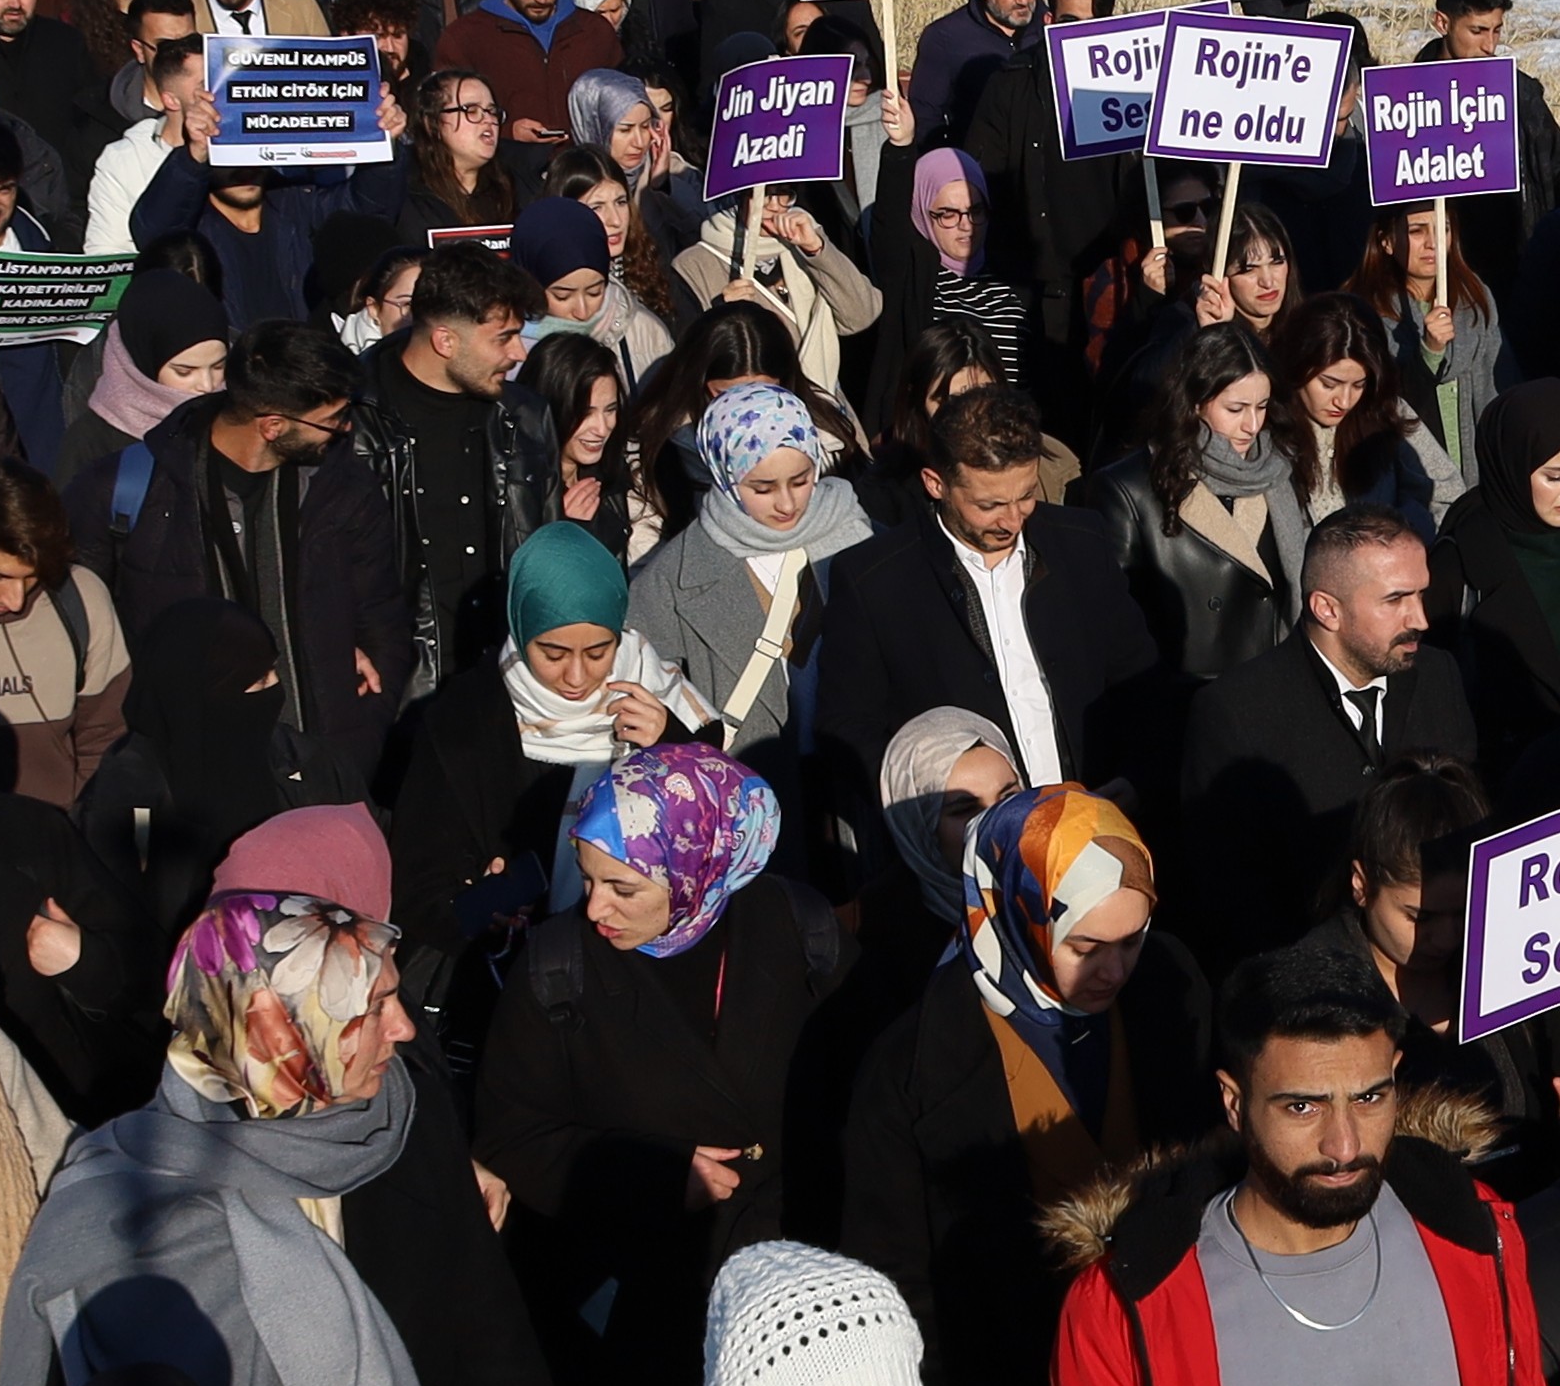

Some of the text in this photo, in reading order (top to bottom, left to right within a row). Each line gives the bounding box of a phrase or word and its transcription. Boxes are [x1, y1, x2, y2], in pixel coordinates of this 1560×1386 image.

[302, 51, 367, 66] KAMPÜS
[1194, 37, 1312, 89] Rojin'e
[232, 82, 364, 99] ETKİN CİTÖK İÇİN
[722, 76, 835, 121] Jin Jiyan
[1373, 79, 1506, 139] Rojin İçin
[246, 115, 350, 129] MÜCADELEYE!
[1179, 104, 1306, 143] ne oldu
[732, 124, 807, 168] Azadî
[1395, 142, 1485, 186] Adalet
[1, 297, 89, 308] KADINLARIN
